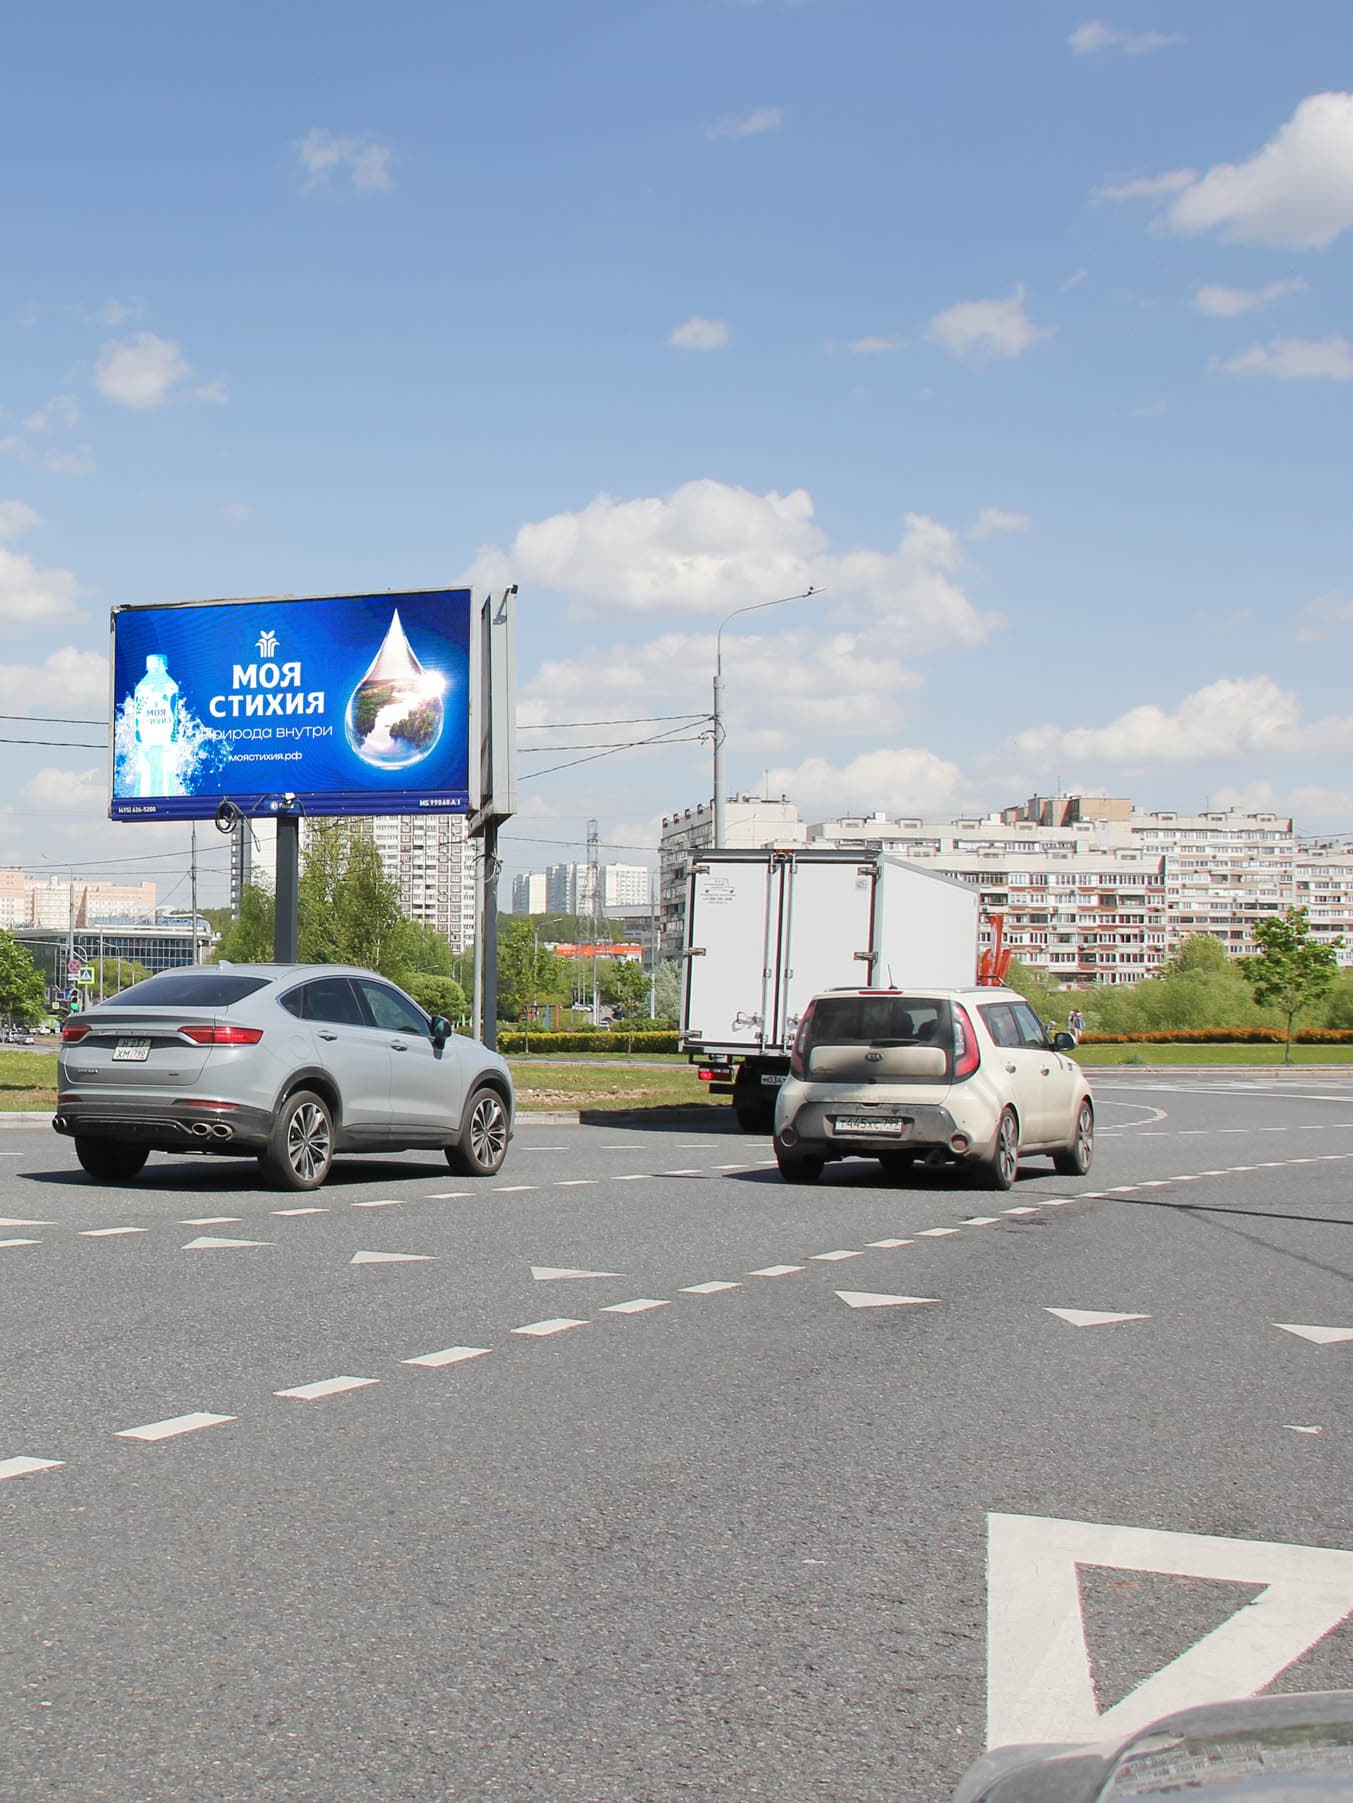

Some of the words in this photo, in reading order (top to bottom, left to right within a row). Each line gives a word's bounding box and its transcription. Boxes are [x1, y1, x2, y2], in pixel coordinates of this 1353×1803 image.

[232, 661, 301, 689] МОЯ
[209, 691, 325, 718] СТИХИЯ
[204, 728, 272, 741] рирода
[276, 726, 333, 740] внутри
[229, 751, 303, 762] моястихия.рф
